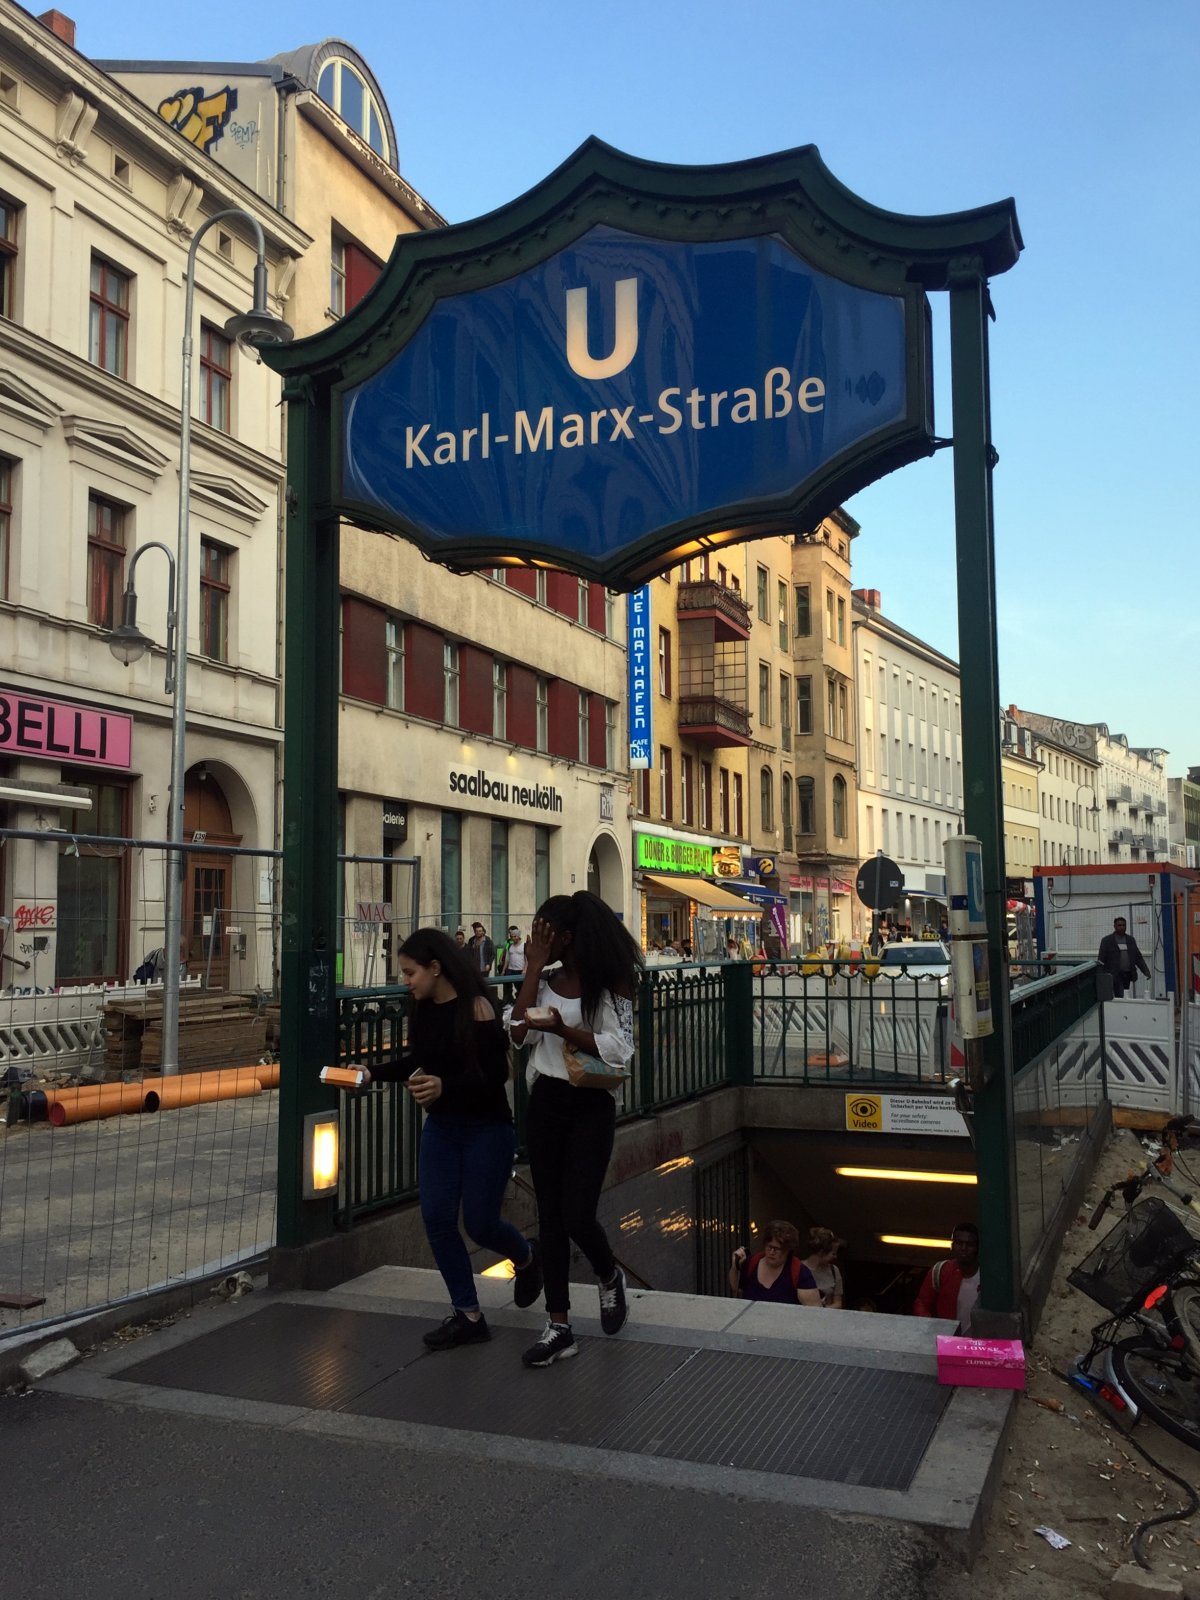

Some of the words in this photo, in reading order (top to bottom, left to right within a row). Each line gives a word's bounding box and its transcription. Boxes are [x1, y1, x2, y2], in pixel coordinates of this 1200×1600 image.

[566, 277, 639, 380] U
[404, 366, 827, 469] Karl-Marx-Straße
[633, 589, 646, 729] HEIMATHAFEN
[449, 769, 509, 803] saalbau
[512, 782, 563, 813] neukölln
[644, 838, 665, 861] DÖNER
[666, 846, 670, 862] &
[671, 844, 693, 865] BURGER
[357, 903, 392, 921] MAC
[852, 1119, 878, 1129] Video
